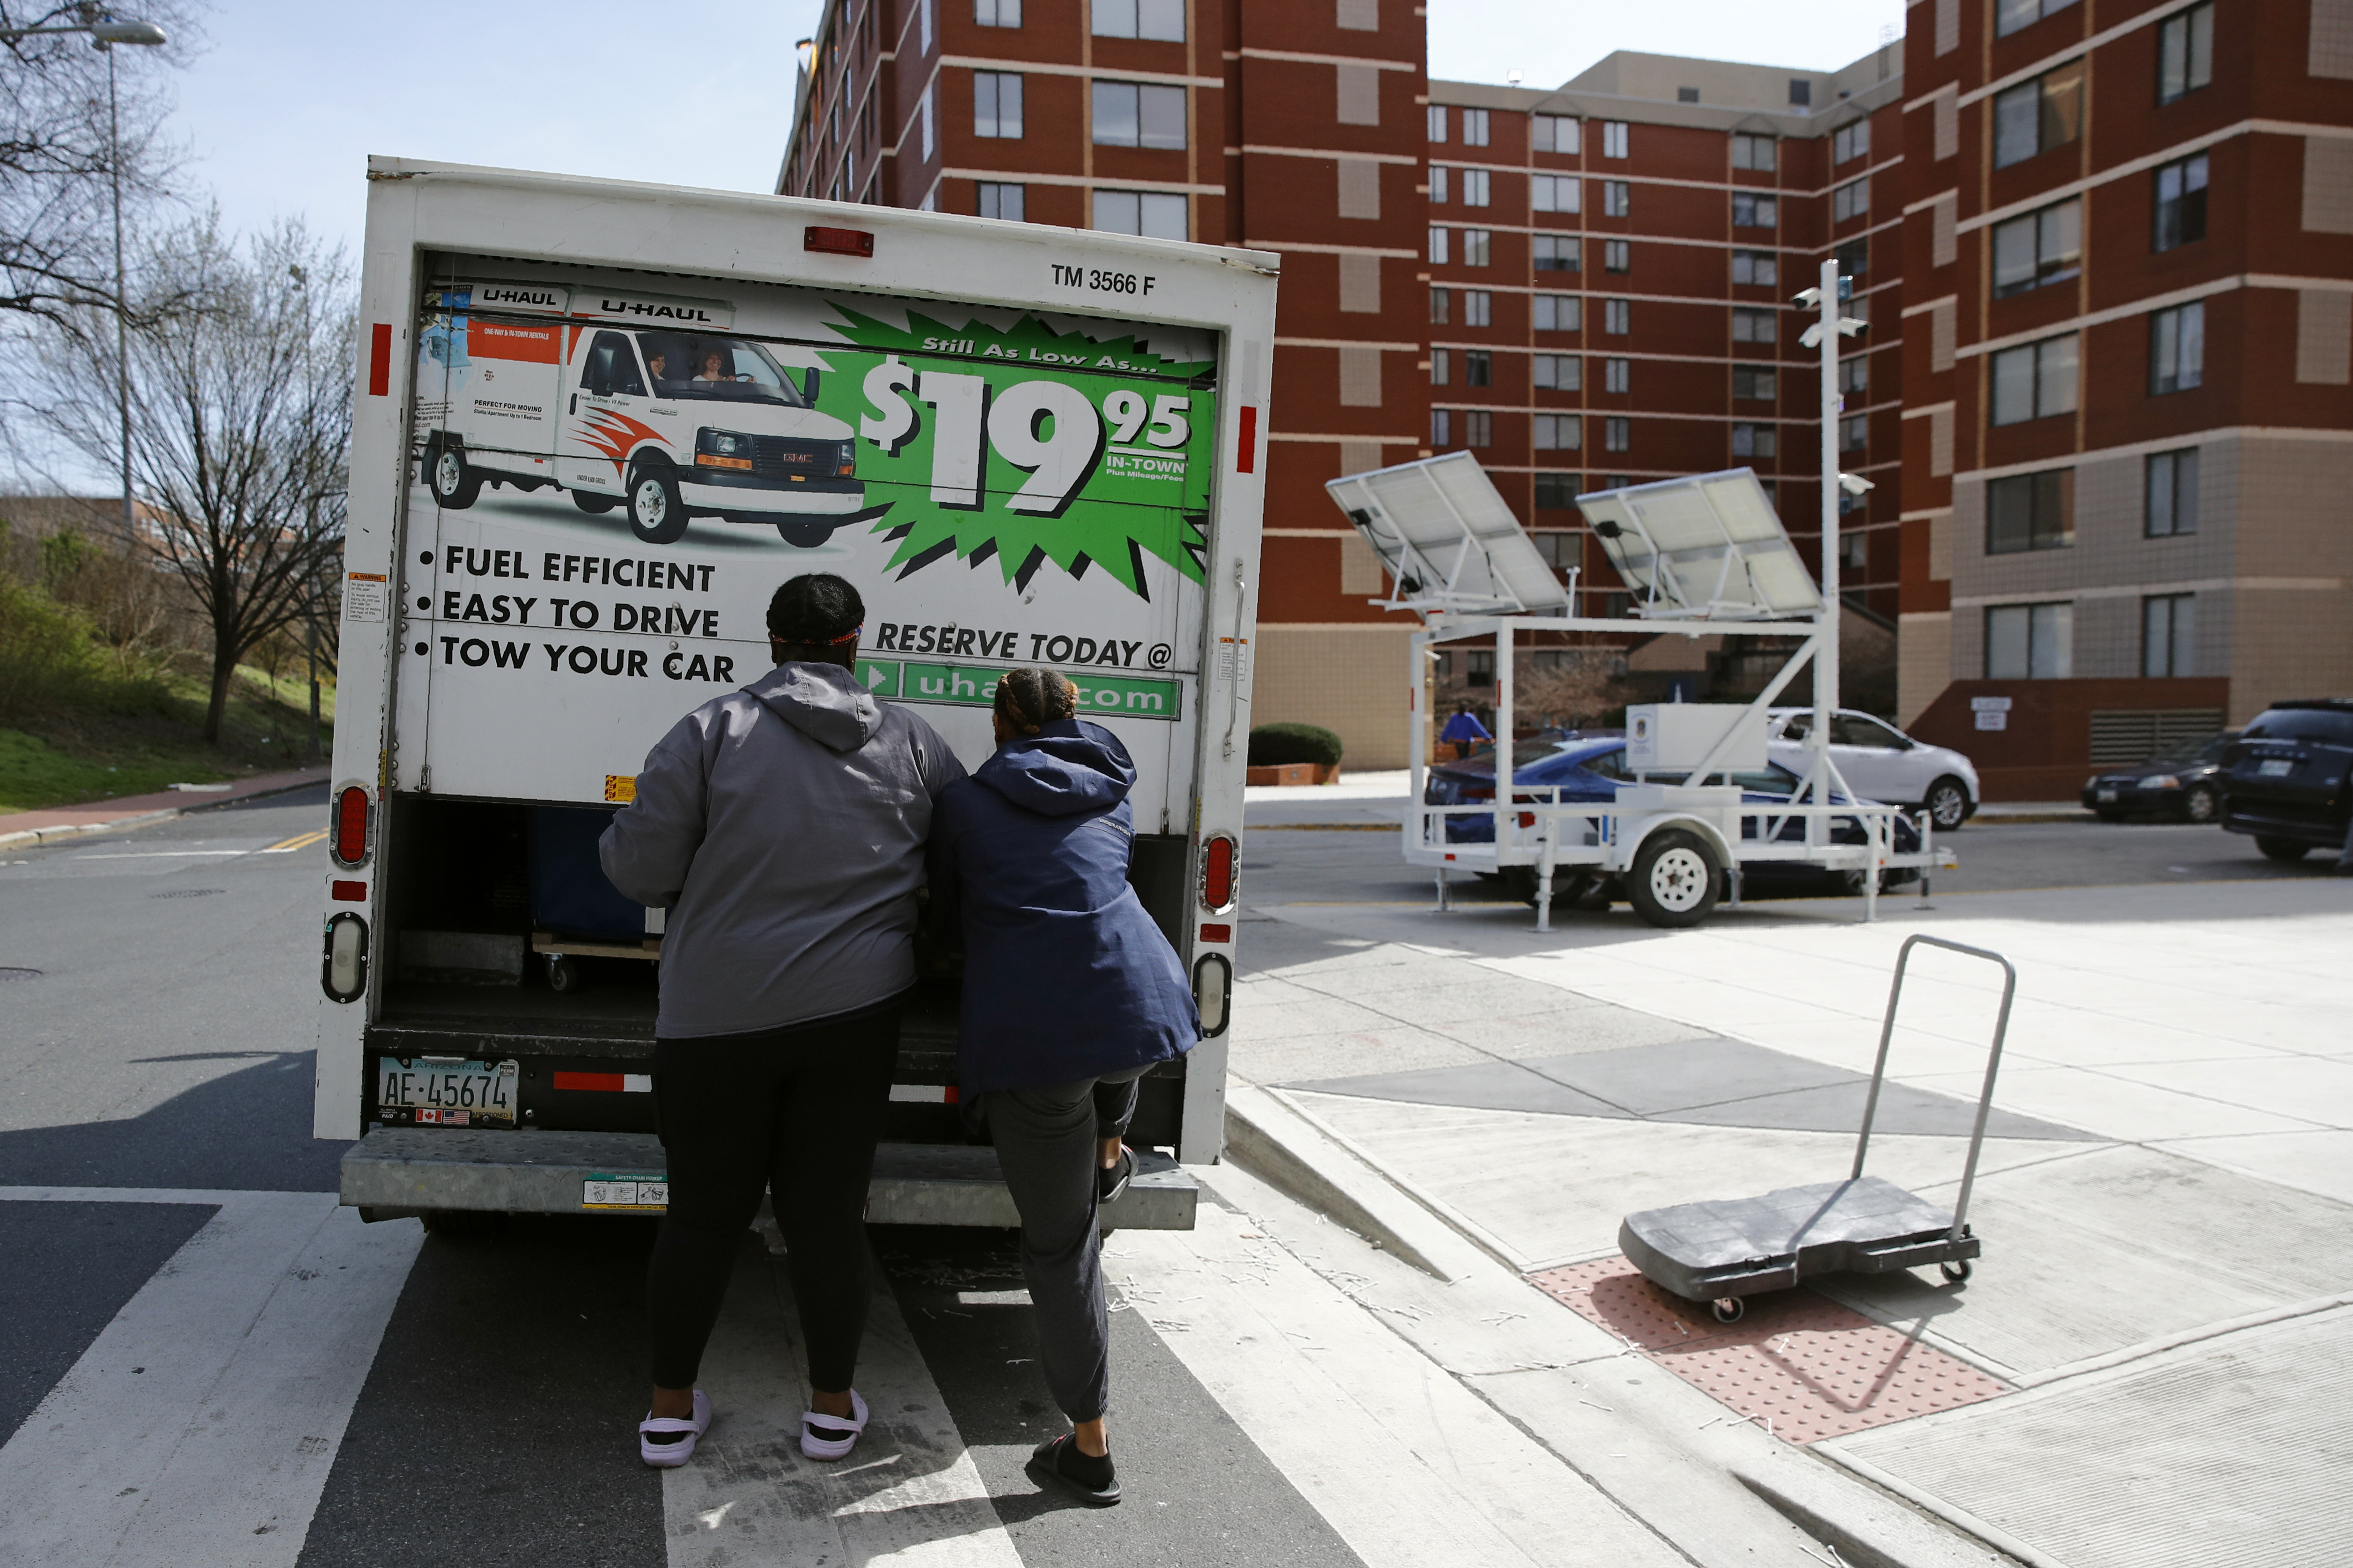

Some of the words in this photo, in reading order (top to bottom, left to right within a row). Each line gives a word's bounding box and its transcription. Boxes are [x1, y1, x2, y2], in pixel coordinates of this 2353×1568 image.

[1051, 264, 1083, 287] TM
[1089, 270, 1137, 294] 3566
[1143, 276, 1155, 296] F
[483, 289, 556, 305] U-HAUL
[601, 299, 711, 322] U-HAUL
[921, 337, 975, 354] Still
[983, 344, 1019, 359] As
[1029, 348, 1087, 365] Low
[1096, 356, 1158, 373] As...
[784, 454, 813, 462] GMC
[1107, 455, 1185, 474] IN-TOWN
[1127, 470, 1184, 482] Mileage/Fees
[446, 545, 529, 579] FUEL
[543, 553, 715, 592] EFFICIENT
[443, 591, 537, 624] EASY
[550, 598, 599, 629] TO
[613, 603, 719, 637] DRIVE
[440, 636, 530, 669] TOW
[543, 644, 649, 678] YOUR
[662, 652, 735, 683] CAR
[876, 623, 1019, 658] RESERVE
[1030, 633, 1143, 667] TODAY
[1147, 642, 1172, 670] @
[920, 672, 1163, 710] uhacom
[414, 1062, 483, 1071] ARIZONA
